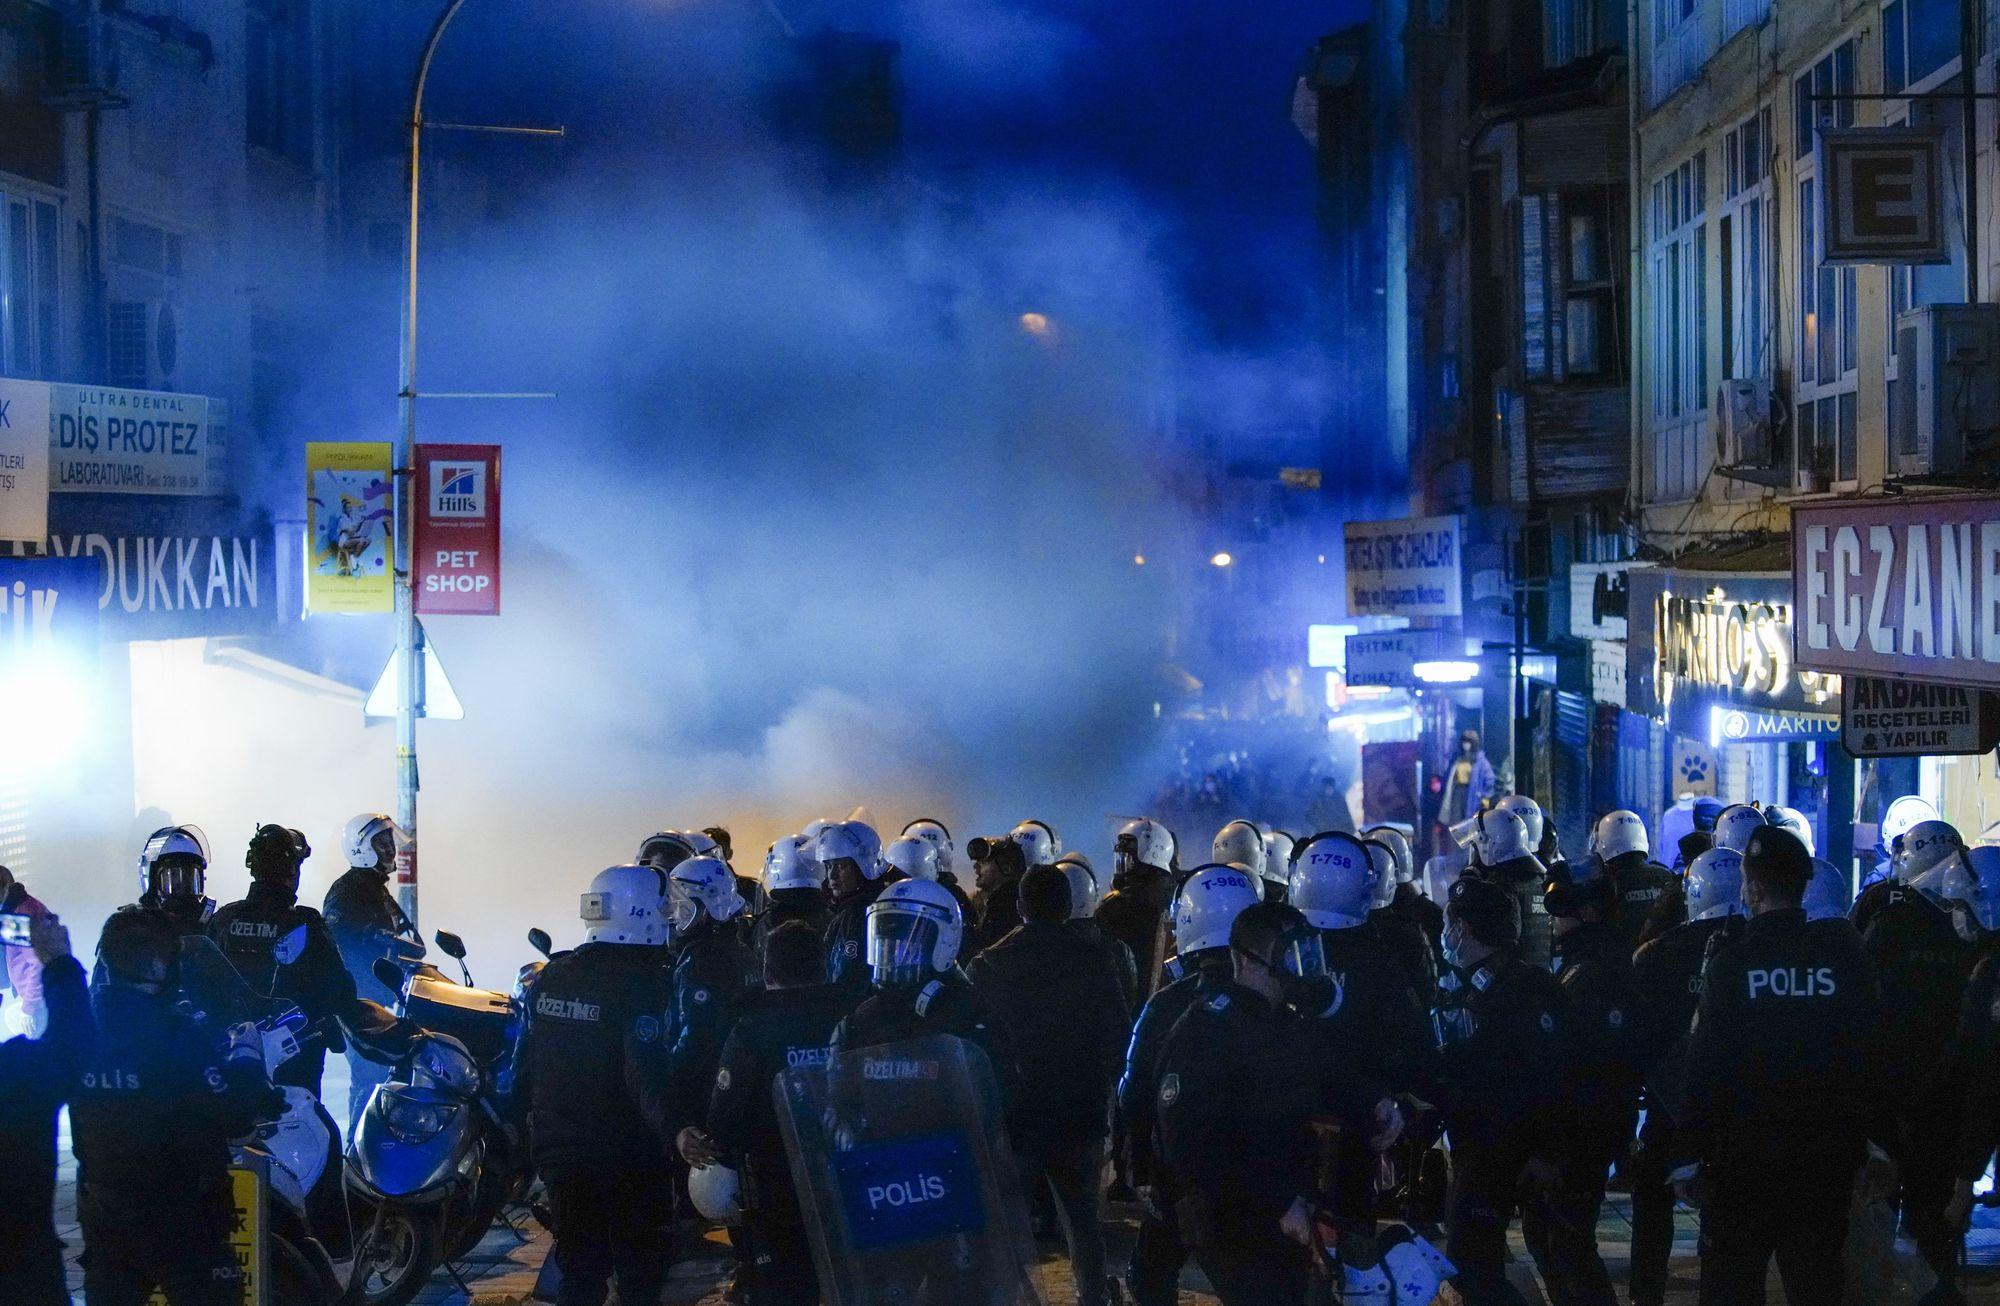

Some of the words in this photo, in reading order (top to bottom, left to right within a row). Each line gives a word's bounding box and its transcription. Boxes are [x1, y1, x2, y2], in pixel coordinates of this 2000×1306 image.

[1851, 158, 1918, 236] E
[79, 391, 126, 407] ULTRA
[133, 396, 184, 412] DENTAL
[59, 407, 100, 455] DİŞ
[108, 416, 198, 456] PROTEZ
[60, 460, 143, 487] LABORATUVARI
[438, 496, 477, 512] Hill's
[436, 551, 479, 569] PET
[12, 533, 258, 614] DUKKAN
[426, 574, 490, 593] SHOP
[1806, 523, 2000, 662] ECZANE
[1853, 709, 1971, 733] REÇETELERİ
[1884, 731, 1949, 748] YAPILIR
[1310, 853, 1352, 869] T-758
[1747, 967, 1836, 999] POLİS
[83, 1069, 139, 1090] OLİS
[867, 1173, 945, 1210] POLİS
